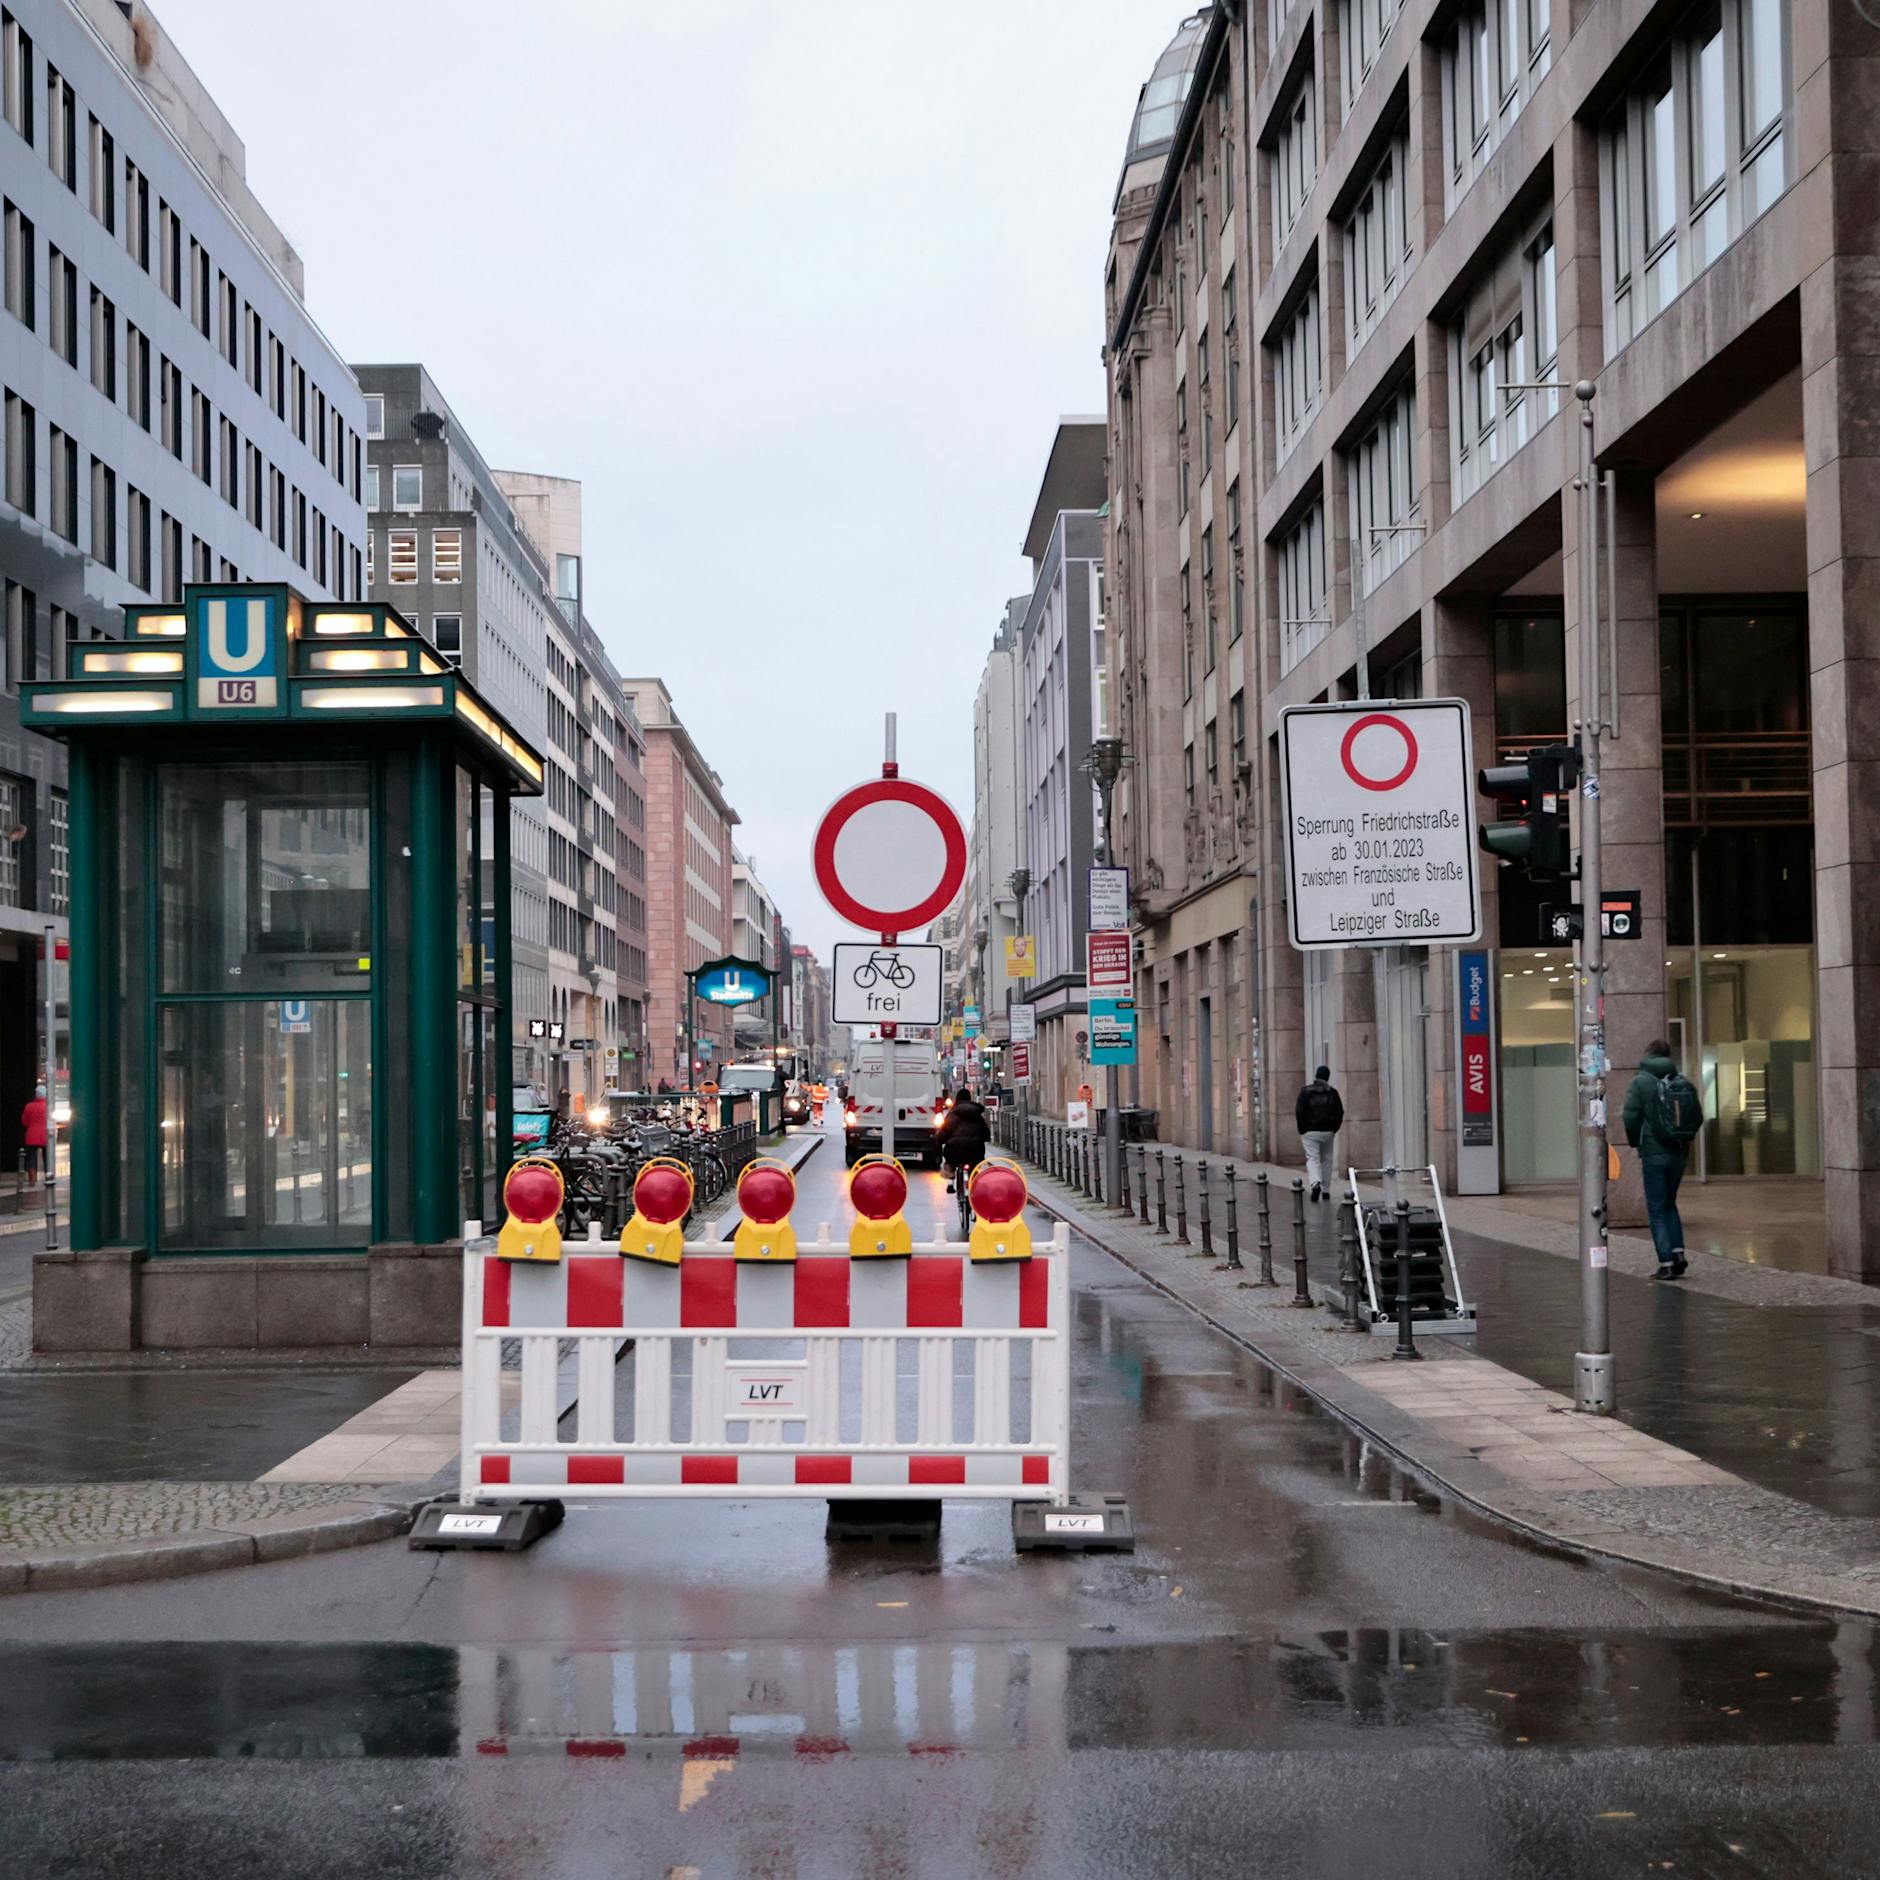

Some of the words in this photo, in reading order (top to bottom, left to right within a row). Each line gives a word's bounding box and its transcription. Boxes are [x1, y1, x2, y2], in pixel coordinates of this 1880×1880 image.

[208, 600, 266, 672] U
[222, 682, 254, 702] U6
[1297, 816, 1354, 839] Sperrung
[1362, 809, 1460, 832] Friedrichstraße
[1331, 842, 1347, 861] ab
[1354, 838, 1424, 860] 30.01.2023
[1301, 867, 1348, 887] zwischen
[1353, 864, 1420, 885] Französische
[1425, 861, 1463, 882] Straße
[1371, 888, 1395, 907] und
[1330, 911, 1387, 936] Leipziger
[1394, 908, 1440, 929] Straße
[1092, 954, 1117, 963] KRIEG
[1118, 953, 1127, 961] IN
[724, 971, 740, 991] U
[1470, 966, 1483, 1005] Budget
[710, 990, 754, 1001] Stadtmitte
[867, 992, 901, 1011] frei
[1469, 1054, 1484, 1094] AVIS
[749, 1384, 784, 1400] LVT
[452, 1519, 488, 1528] LVT
[1057, 1519, 1091, 1528] LVT
